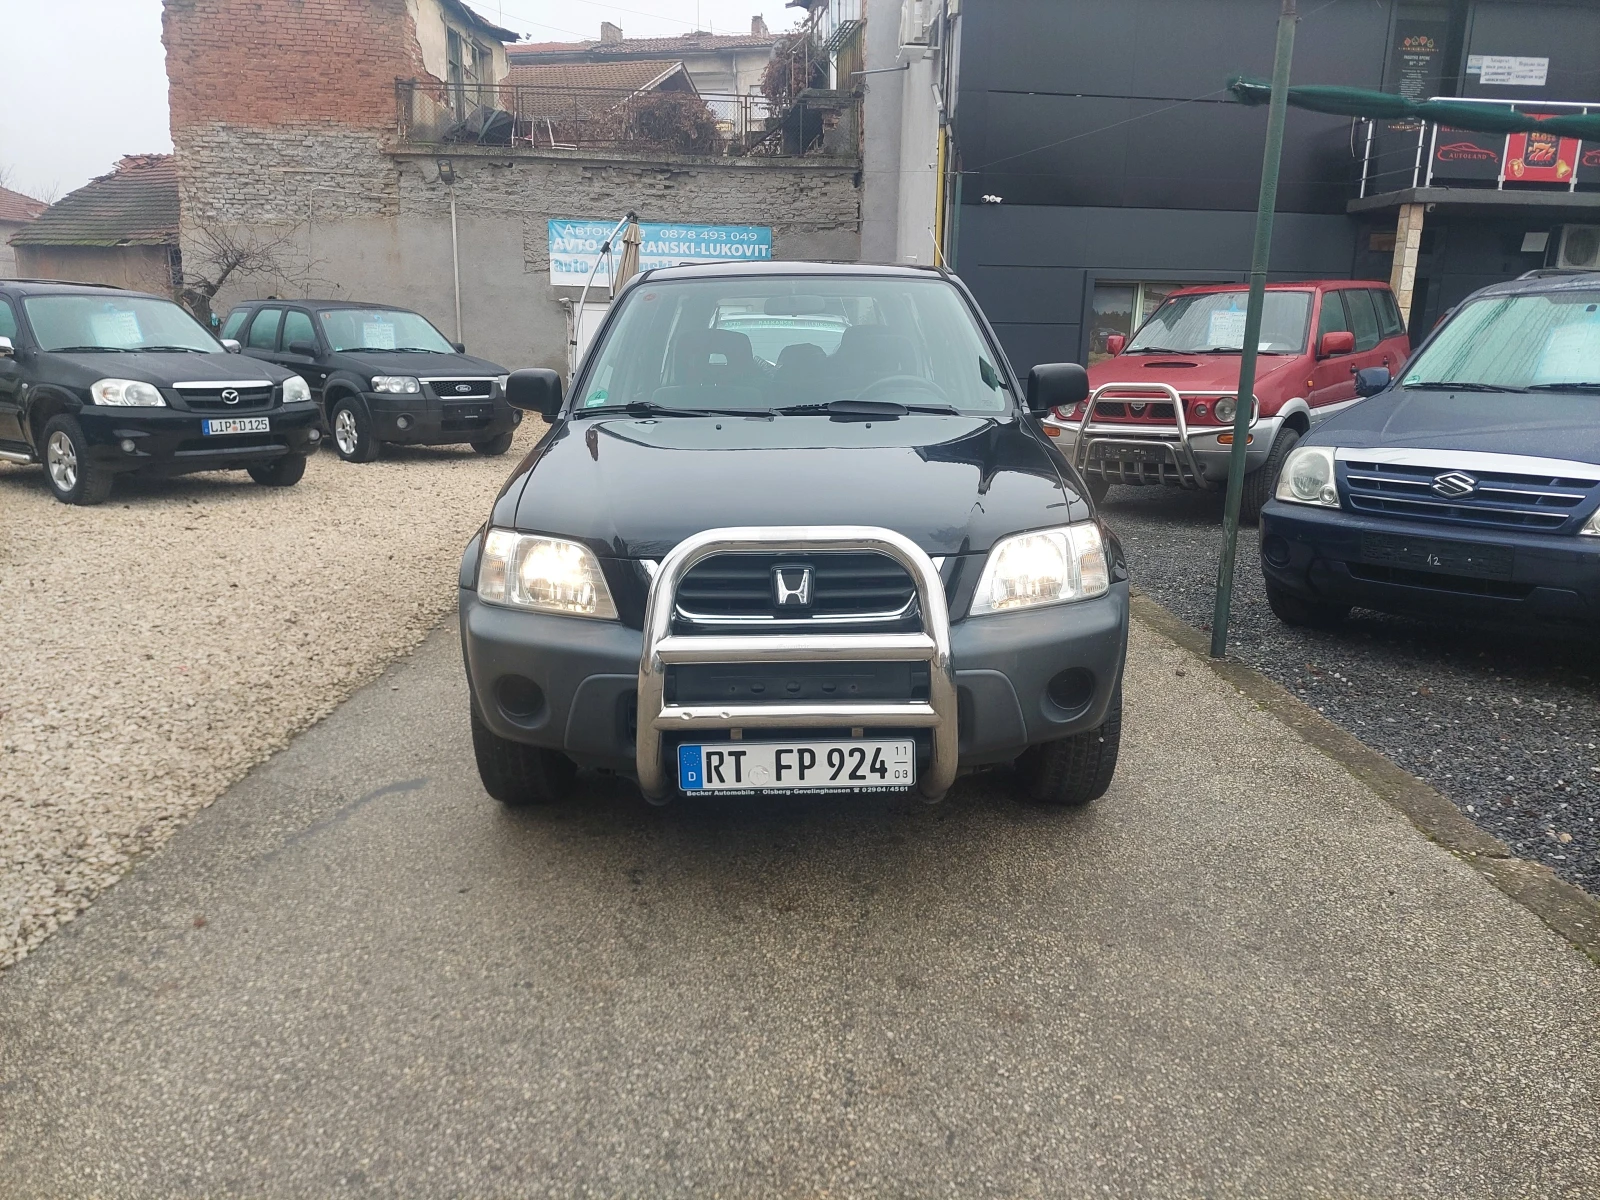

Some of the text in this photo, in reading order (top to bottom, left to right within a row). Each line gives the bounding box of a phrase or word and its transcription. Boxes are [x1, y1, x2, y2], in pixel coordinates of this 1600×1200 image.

[1449, 152, 1487, 160] AUTOLAND
[1527, 142, 1556, 161] 777
[660, 229, 696, 239] 0878
[699, 230, 726, 241] 493
[730, 231, 758, 242] 049
[210, 421, 231, 433] LIP
[239, 420, 246, 432] D
[248, 419, 267, 431] 125
[1427, 553, 1442, 566] 12
[895, 746, 907, 756] 11
[688, 747, 888, 784] D RT FP 924
